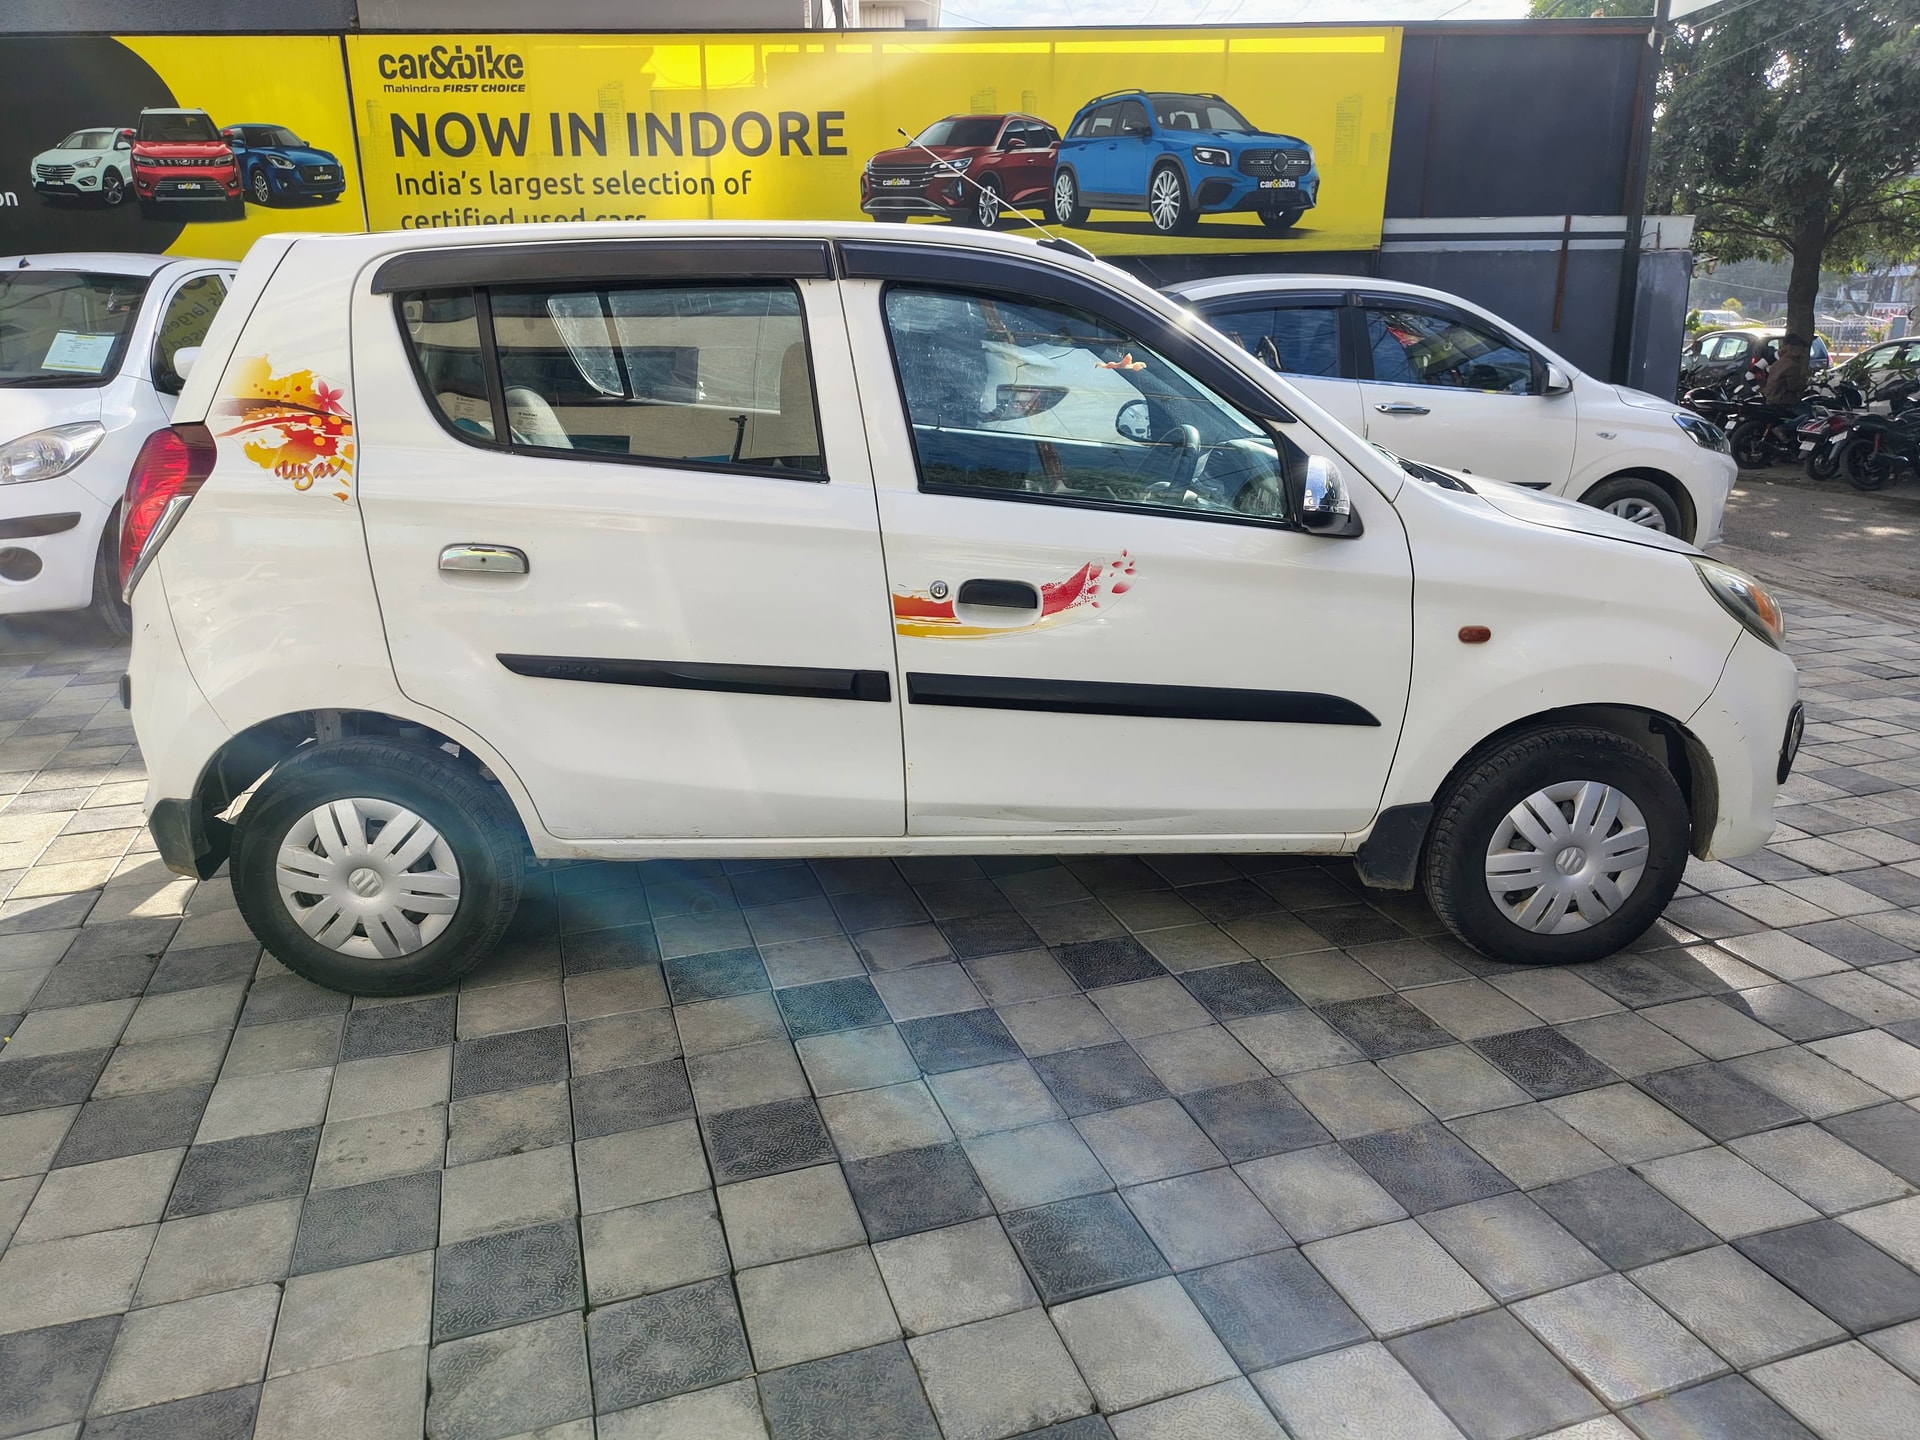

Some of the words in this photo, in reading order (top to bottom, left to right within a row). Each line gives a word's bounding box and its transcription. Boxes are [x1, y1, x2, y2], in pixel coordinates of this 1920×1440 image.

[378, 45, 524, 79] car&bike
[383, 84, 440, 93] Mahindra
[443, 84, 479, 93] FIRST
[481, 84, 526, 93] CHOICE
[390, 112, 530, 157] NOW
[549, 112, 608, 157] IN
[626, 111, 848, 157] INDORE
[395, 170, 483, 195] India's
[489, 170, 585, 200] largest
[592, 170, 715, 195] selection
[724, 170, 752, 195] of
